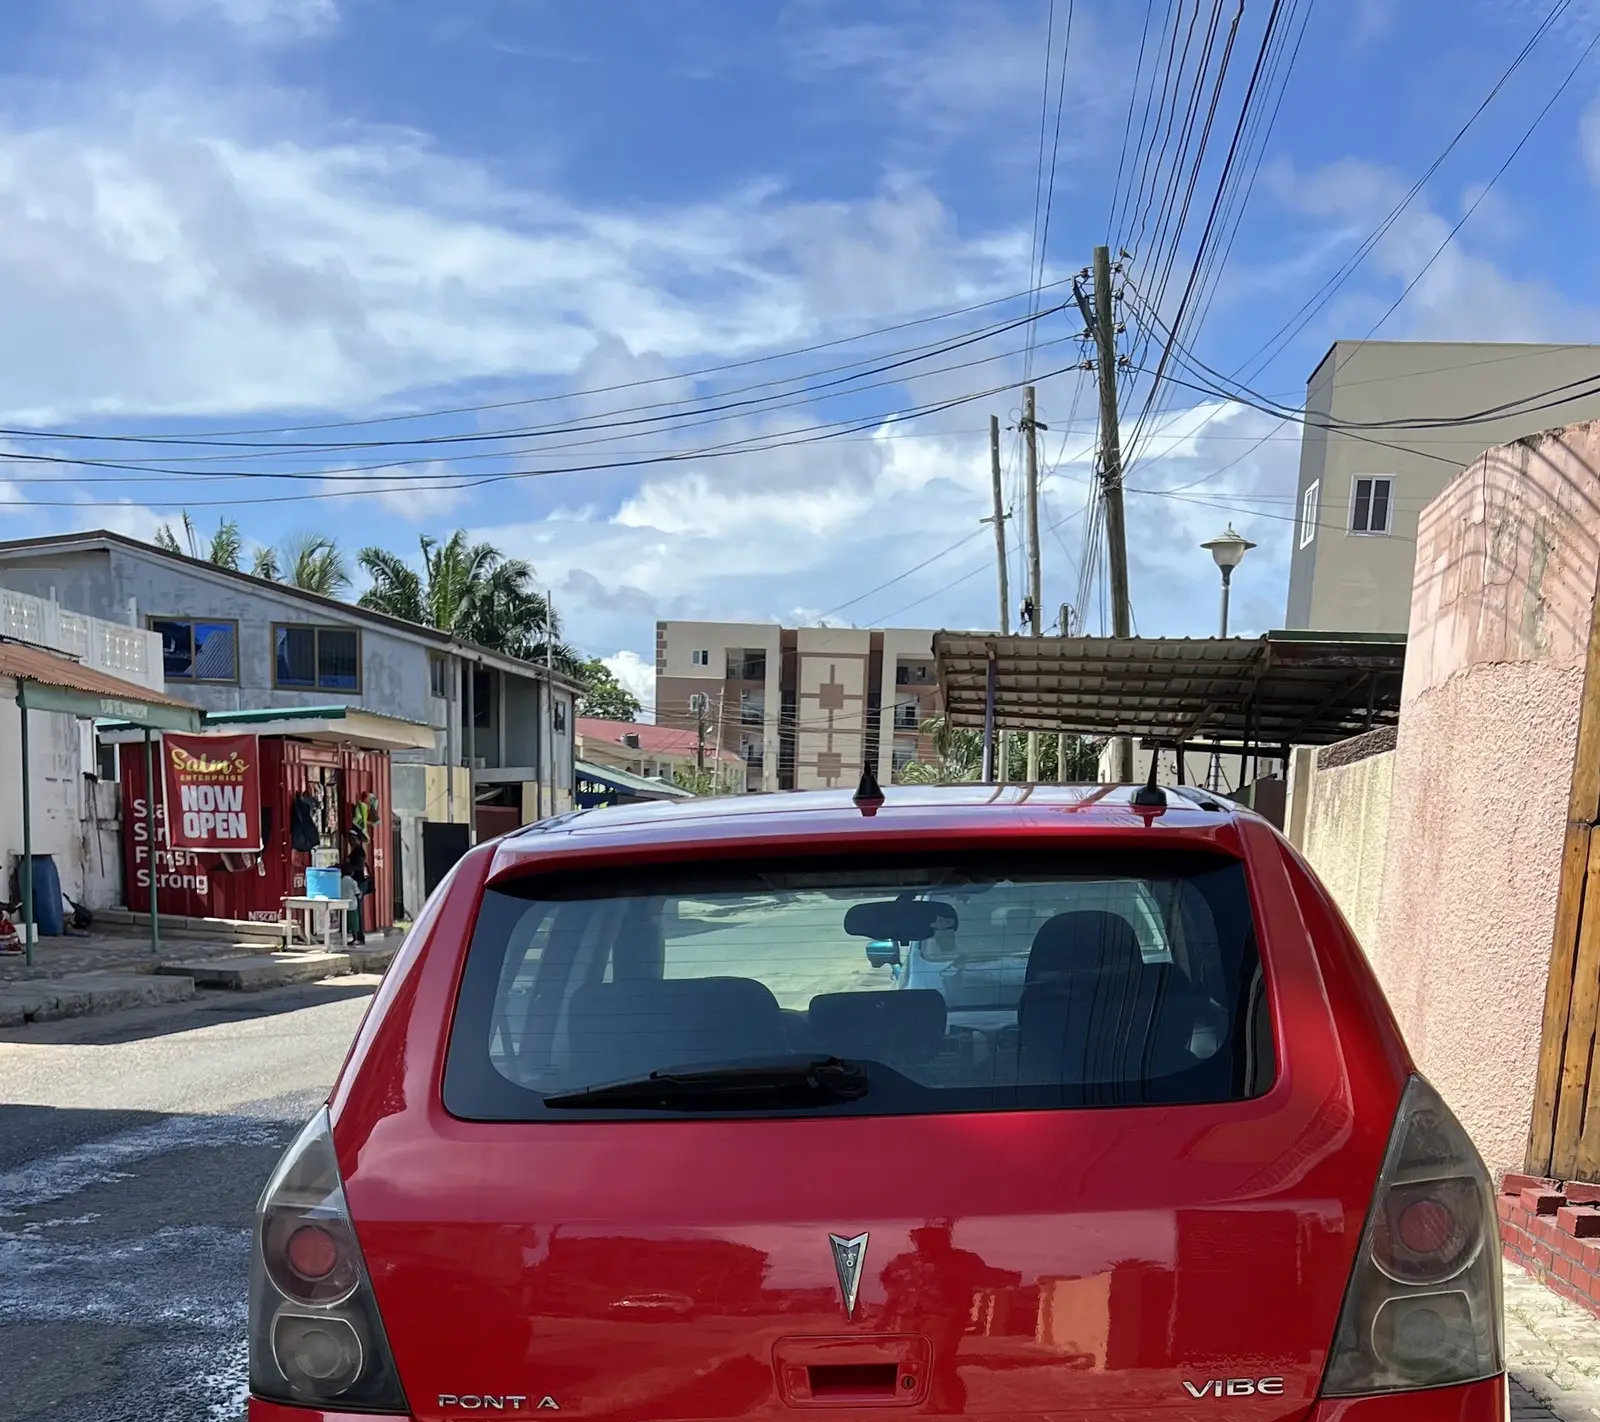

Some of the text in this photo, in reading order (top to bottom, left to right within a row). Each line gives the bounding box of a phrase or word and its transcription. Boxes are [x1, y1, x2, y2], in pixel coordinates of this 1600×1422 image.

[181, 785, 244, 812] NOW
[183, 812, 248, 839] OPEN
[135, 846, 199, 867] Fnsh
[1182, 1377, 1284, 1398] VIBE
